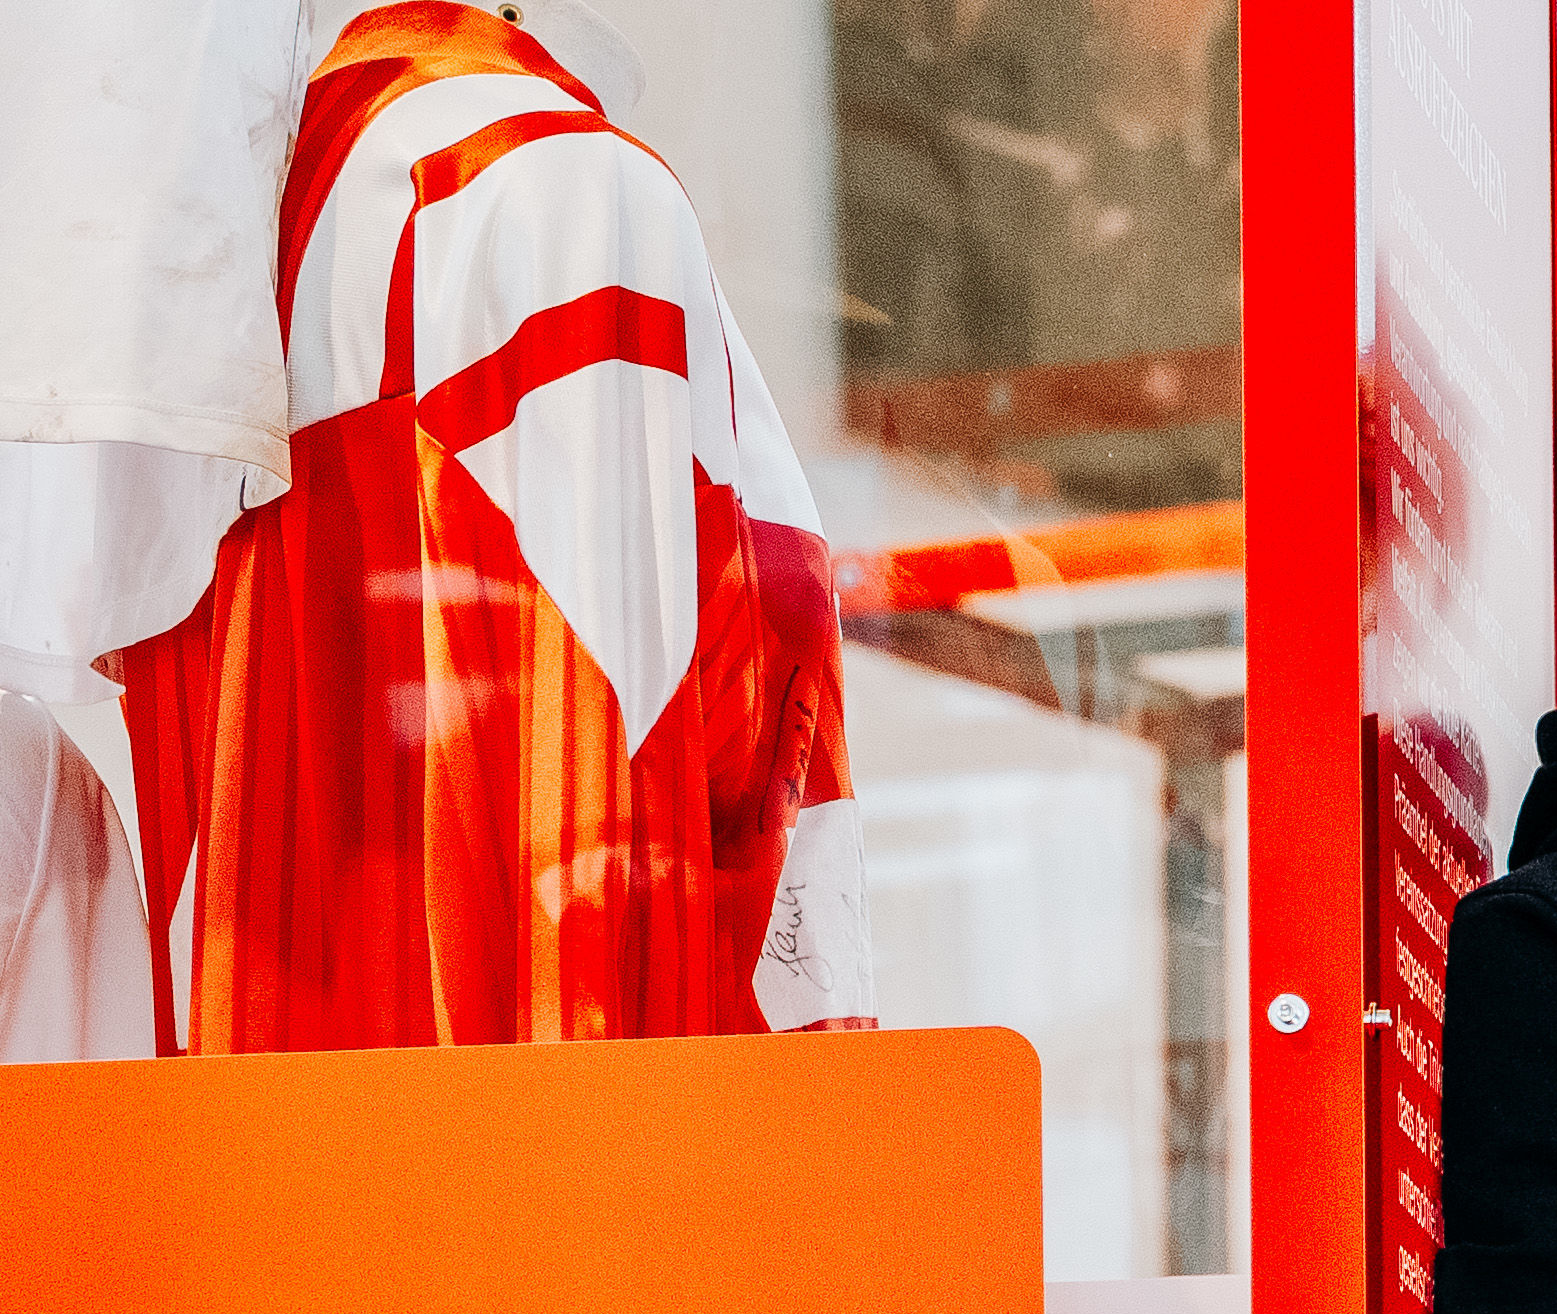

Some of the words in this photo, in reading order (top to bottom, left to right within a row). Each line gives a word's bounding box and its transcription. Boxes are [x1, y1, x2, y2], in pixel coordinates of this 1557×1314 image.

[1388, 0, 1507, 235] AUSRUFEZEICHEN
[1389, 312, 1442, 444] Verantwortung
[1442, 400, 1457, 453] und
[1390, 391, 1400, 449] ist
[1400, 415, 1415, 469] uns
[1415, 435, 1444, 519] wichtig.
[1390, 464, 1404, 528] Wir
[1404, 483, 1431, 565] fördern
[1431, 532, 1446, 587] und
[1393, 694, 1413, 767] Diese
[1393, 770, 1427, 859] Präambel
[1428, 825, 1441, 875] der
[1394, 845, 1447, 968] Vereinssatzung
[1396, 999, 1414, 1069] Auch
[1415, 1033, 1427, 1083] die
[1397, 1080, 1414, 1144] dass
[1415, 1104, 1427, 1158] der
